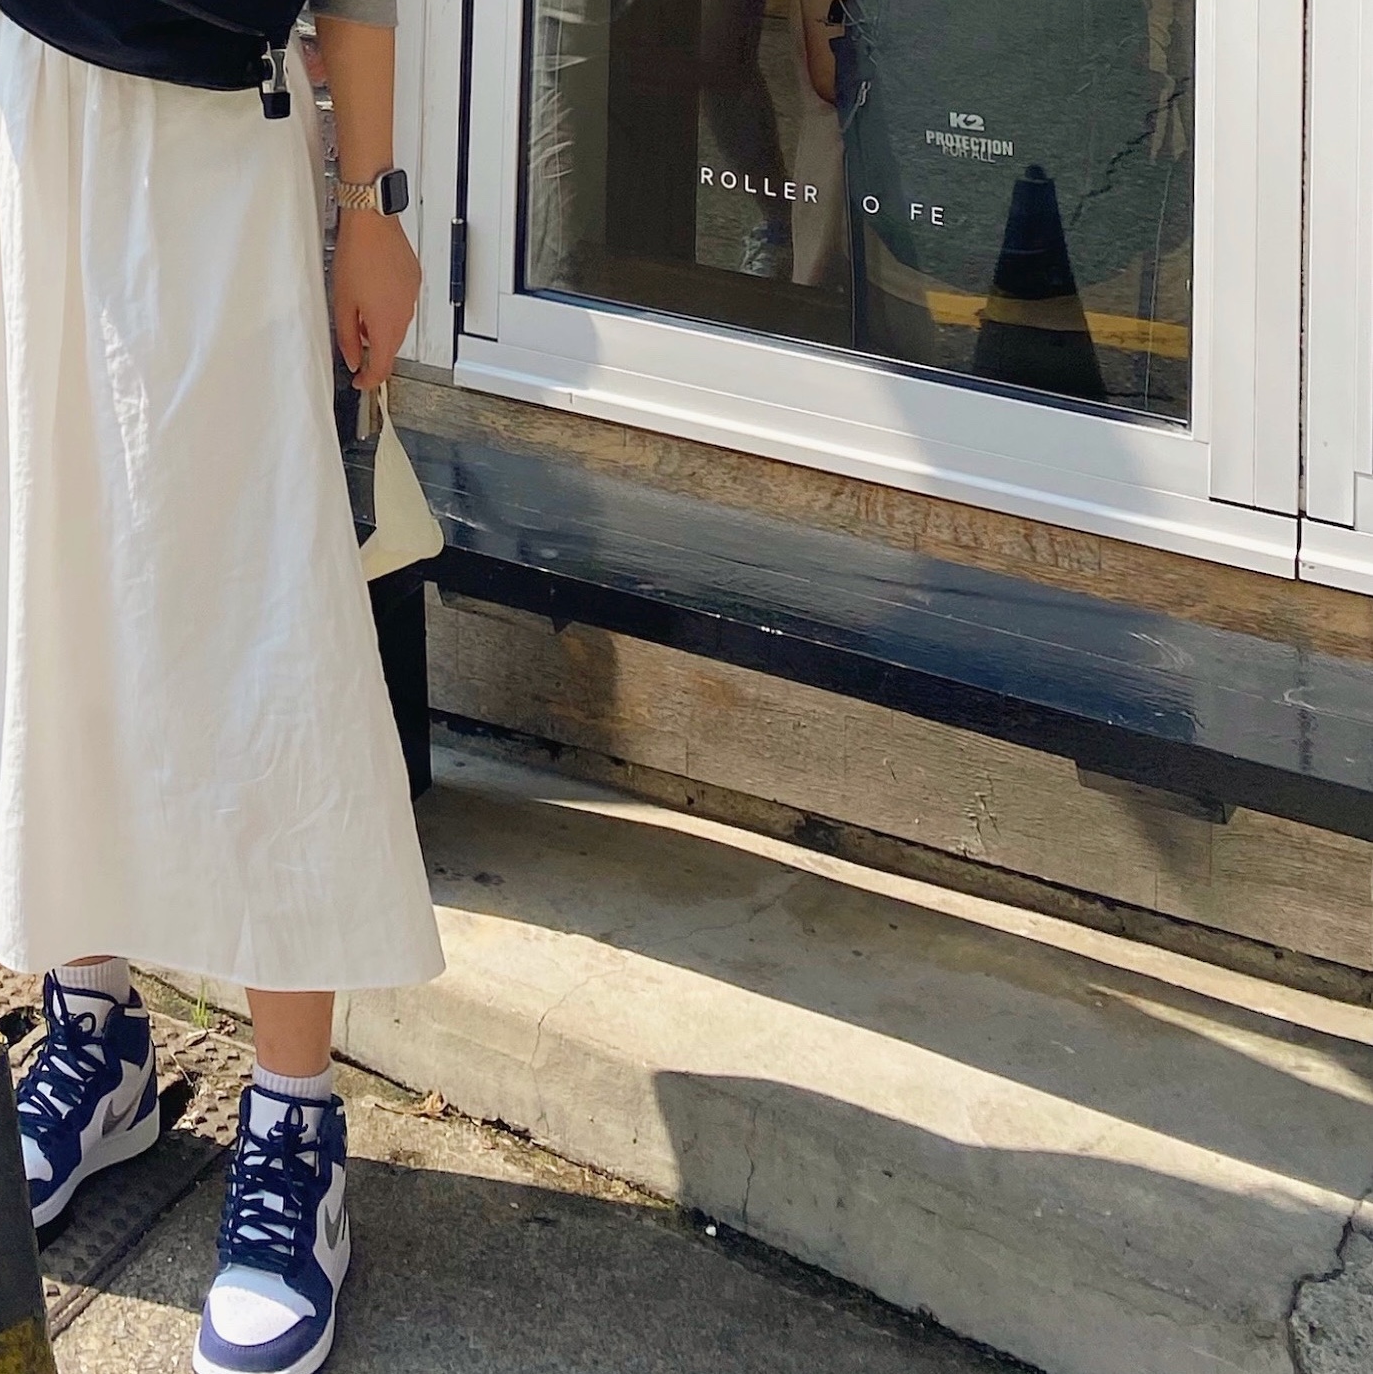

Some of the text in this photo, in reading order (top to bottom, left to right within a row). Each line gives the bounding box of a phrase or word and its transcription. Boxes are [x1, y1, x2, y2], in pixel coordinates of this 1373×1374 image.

[949, 111, 985, 131] K2
[926, 130, 1014, 157] PROTECTION
[700, 166, 818, 204] ROLLER
